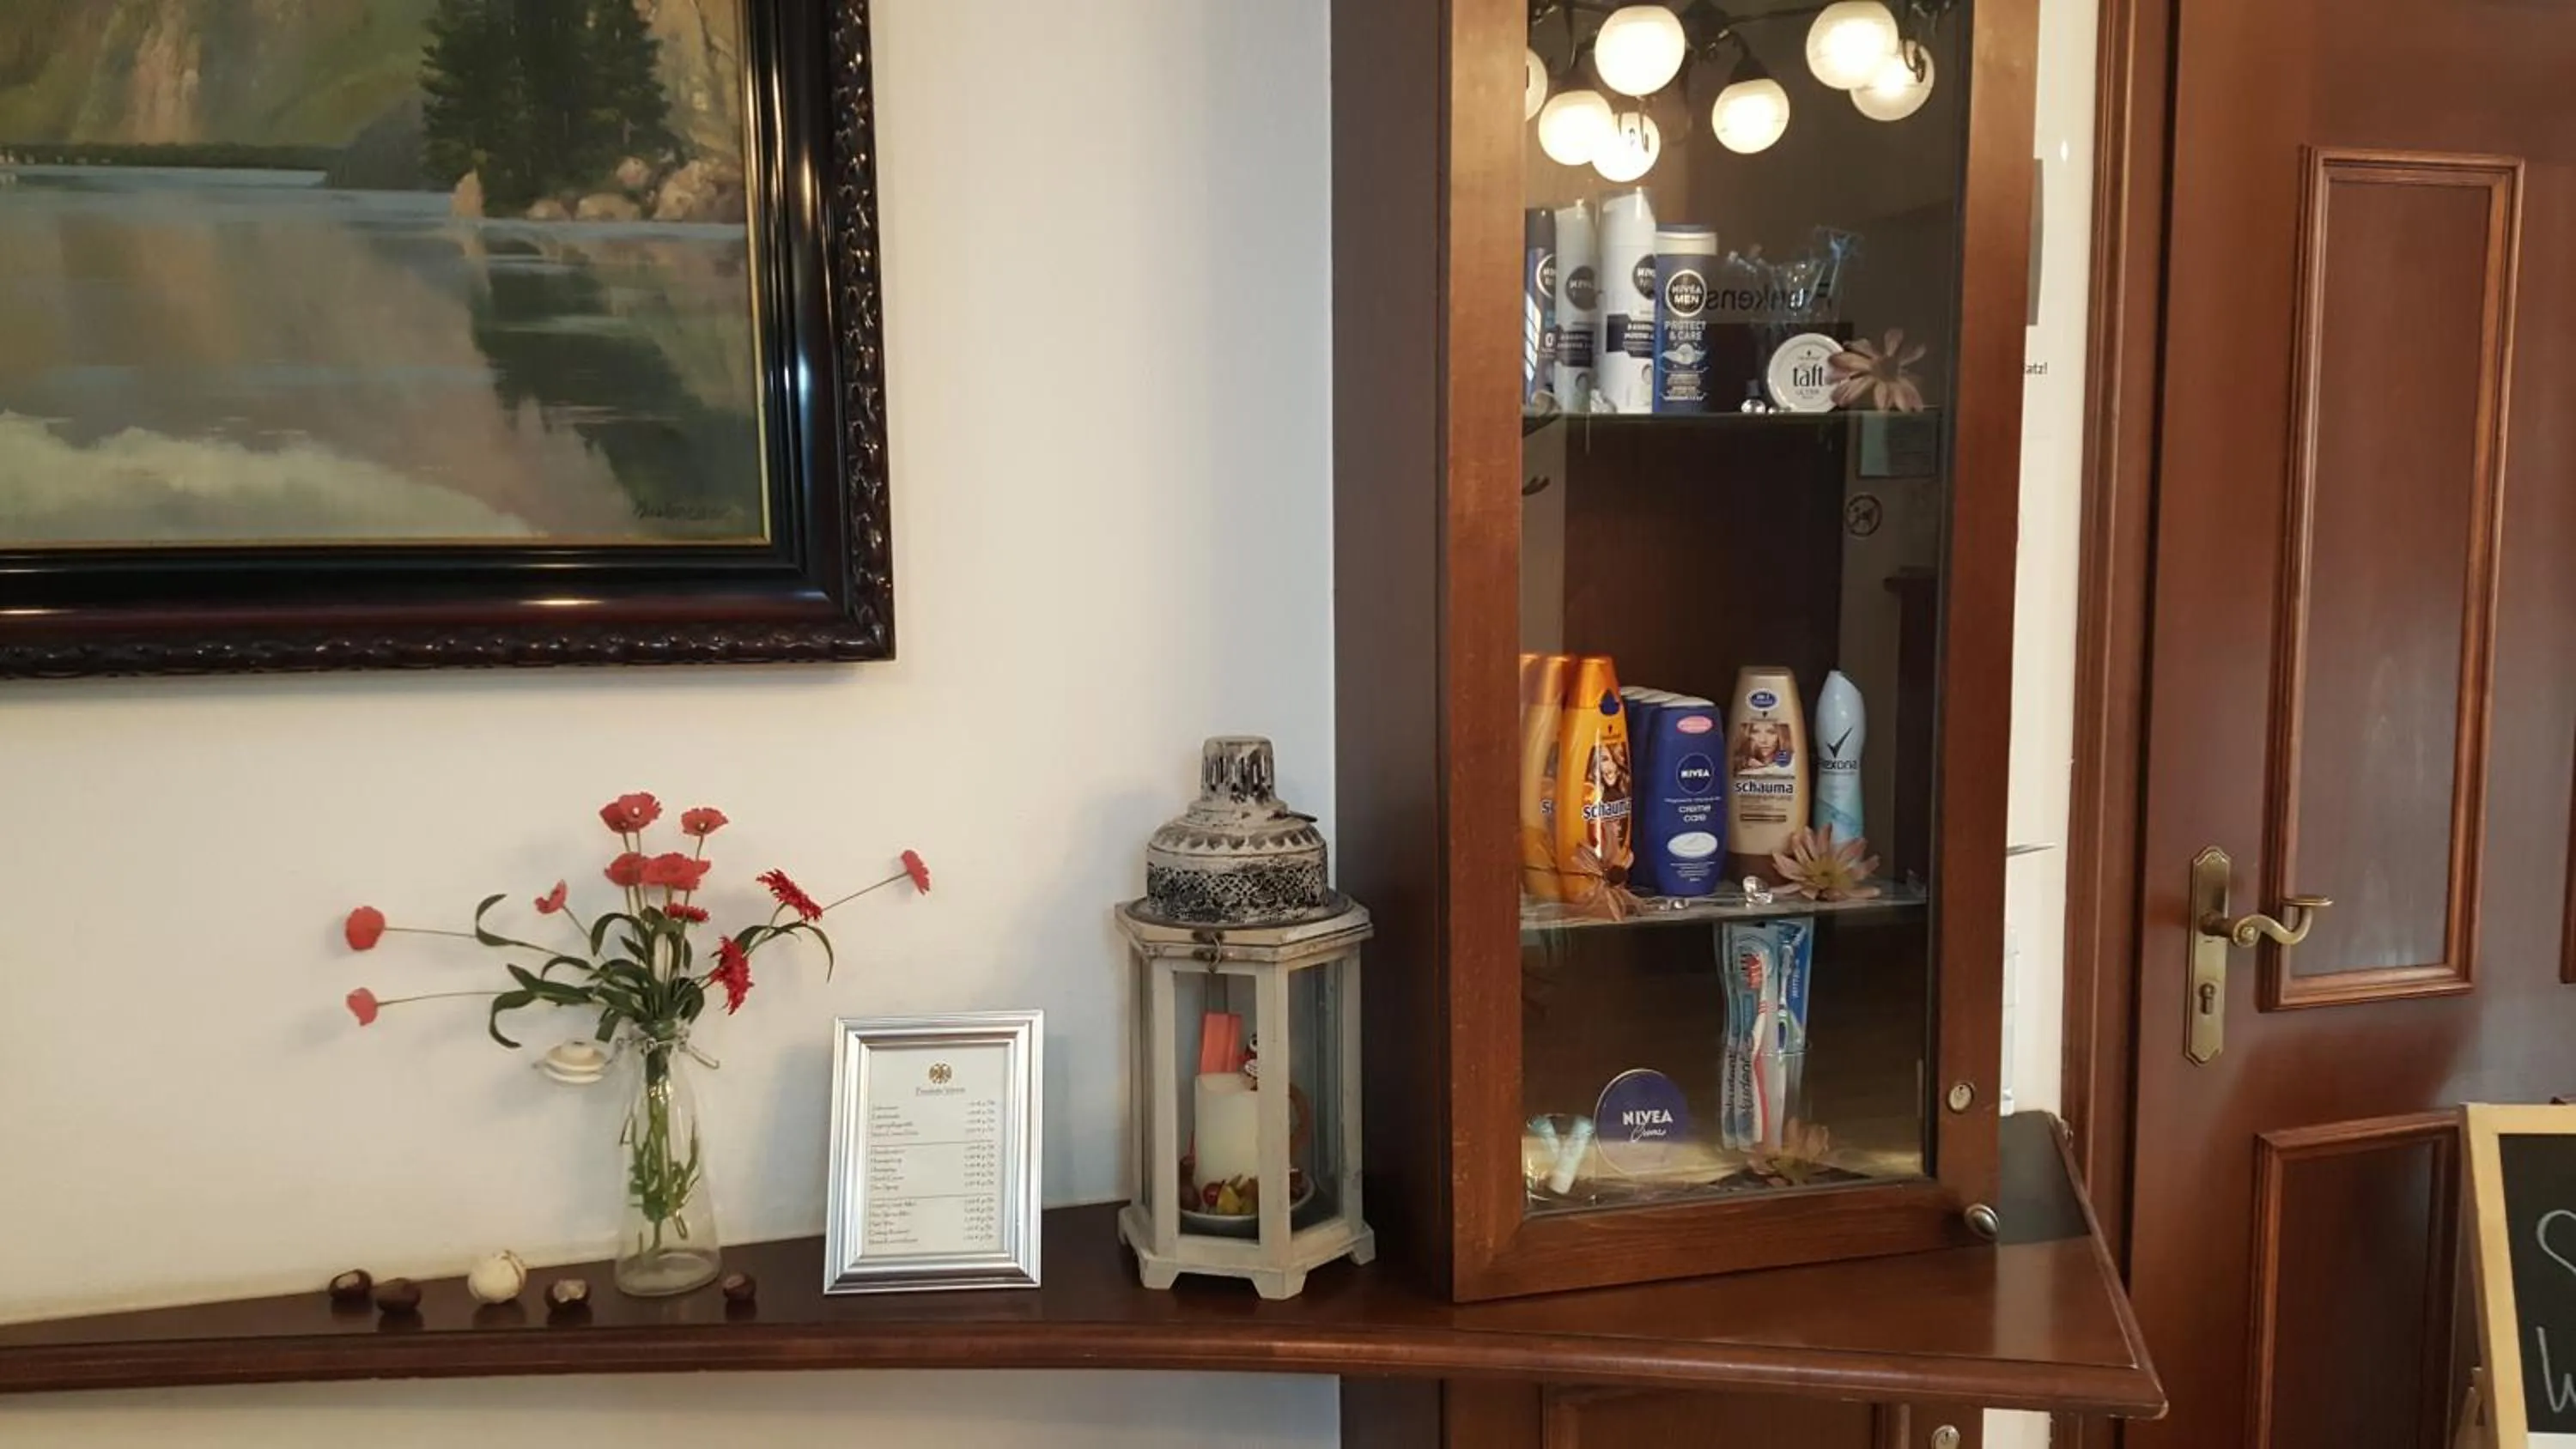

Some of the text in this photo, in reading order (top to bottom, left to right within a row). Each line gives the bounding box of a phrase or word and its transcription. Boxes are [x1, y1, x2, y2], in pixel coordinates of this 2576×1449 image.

[1636, 267, 1654, 277] NIV
[1671, 285, 1703, 295] NIVEA
[1674, 294, 1700, 305] MEN
[1664, 320, 1707, 330] PROTECT
[1678, 330, 1703, 341] CARE
[2026, 361, 2049, 375] atz!
[1793, 363, 1824, 387] taft
[1680, 768, 1710, 779] NIVEA
[1735, 779, 1795, 795] schauma
[1622, 1108, 1674, 1125] NIVEA
